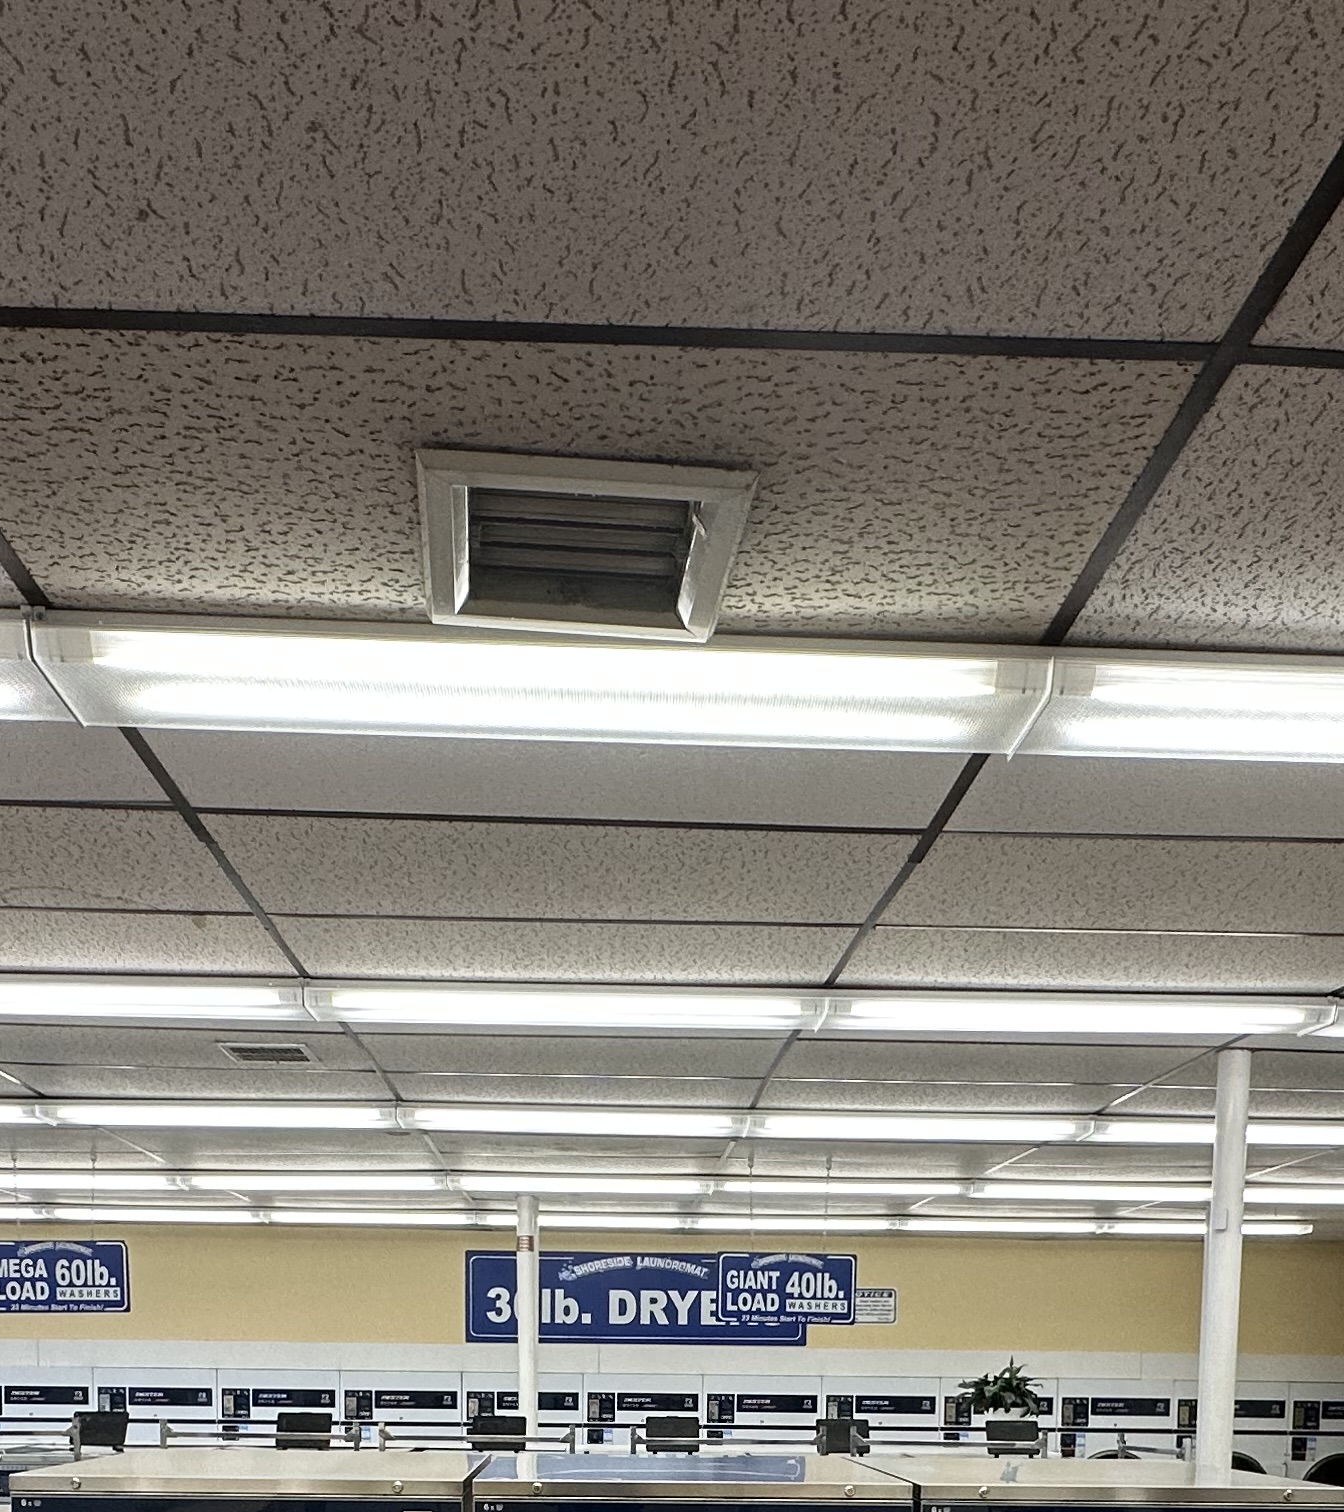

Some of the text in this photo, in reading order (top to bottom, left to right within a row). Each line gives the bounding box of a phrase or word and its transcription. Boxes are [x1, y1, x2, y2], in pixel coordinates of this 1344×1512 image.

[56, 1258, 116, 1286] 60lb.
[574, 1256, 710, 1279] SHORESIDE LAUNDROMAT
[58, 1288, 119, 1298] WASHERS
[726, 1270, 844, 1298] GIANT 40lb.
[486, 1287, 591, 1324] 3lb.
[726, 1292, 780, 1312] LOAD
[788, 1301, 846, 1311] WASHERS
